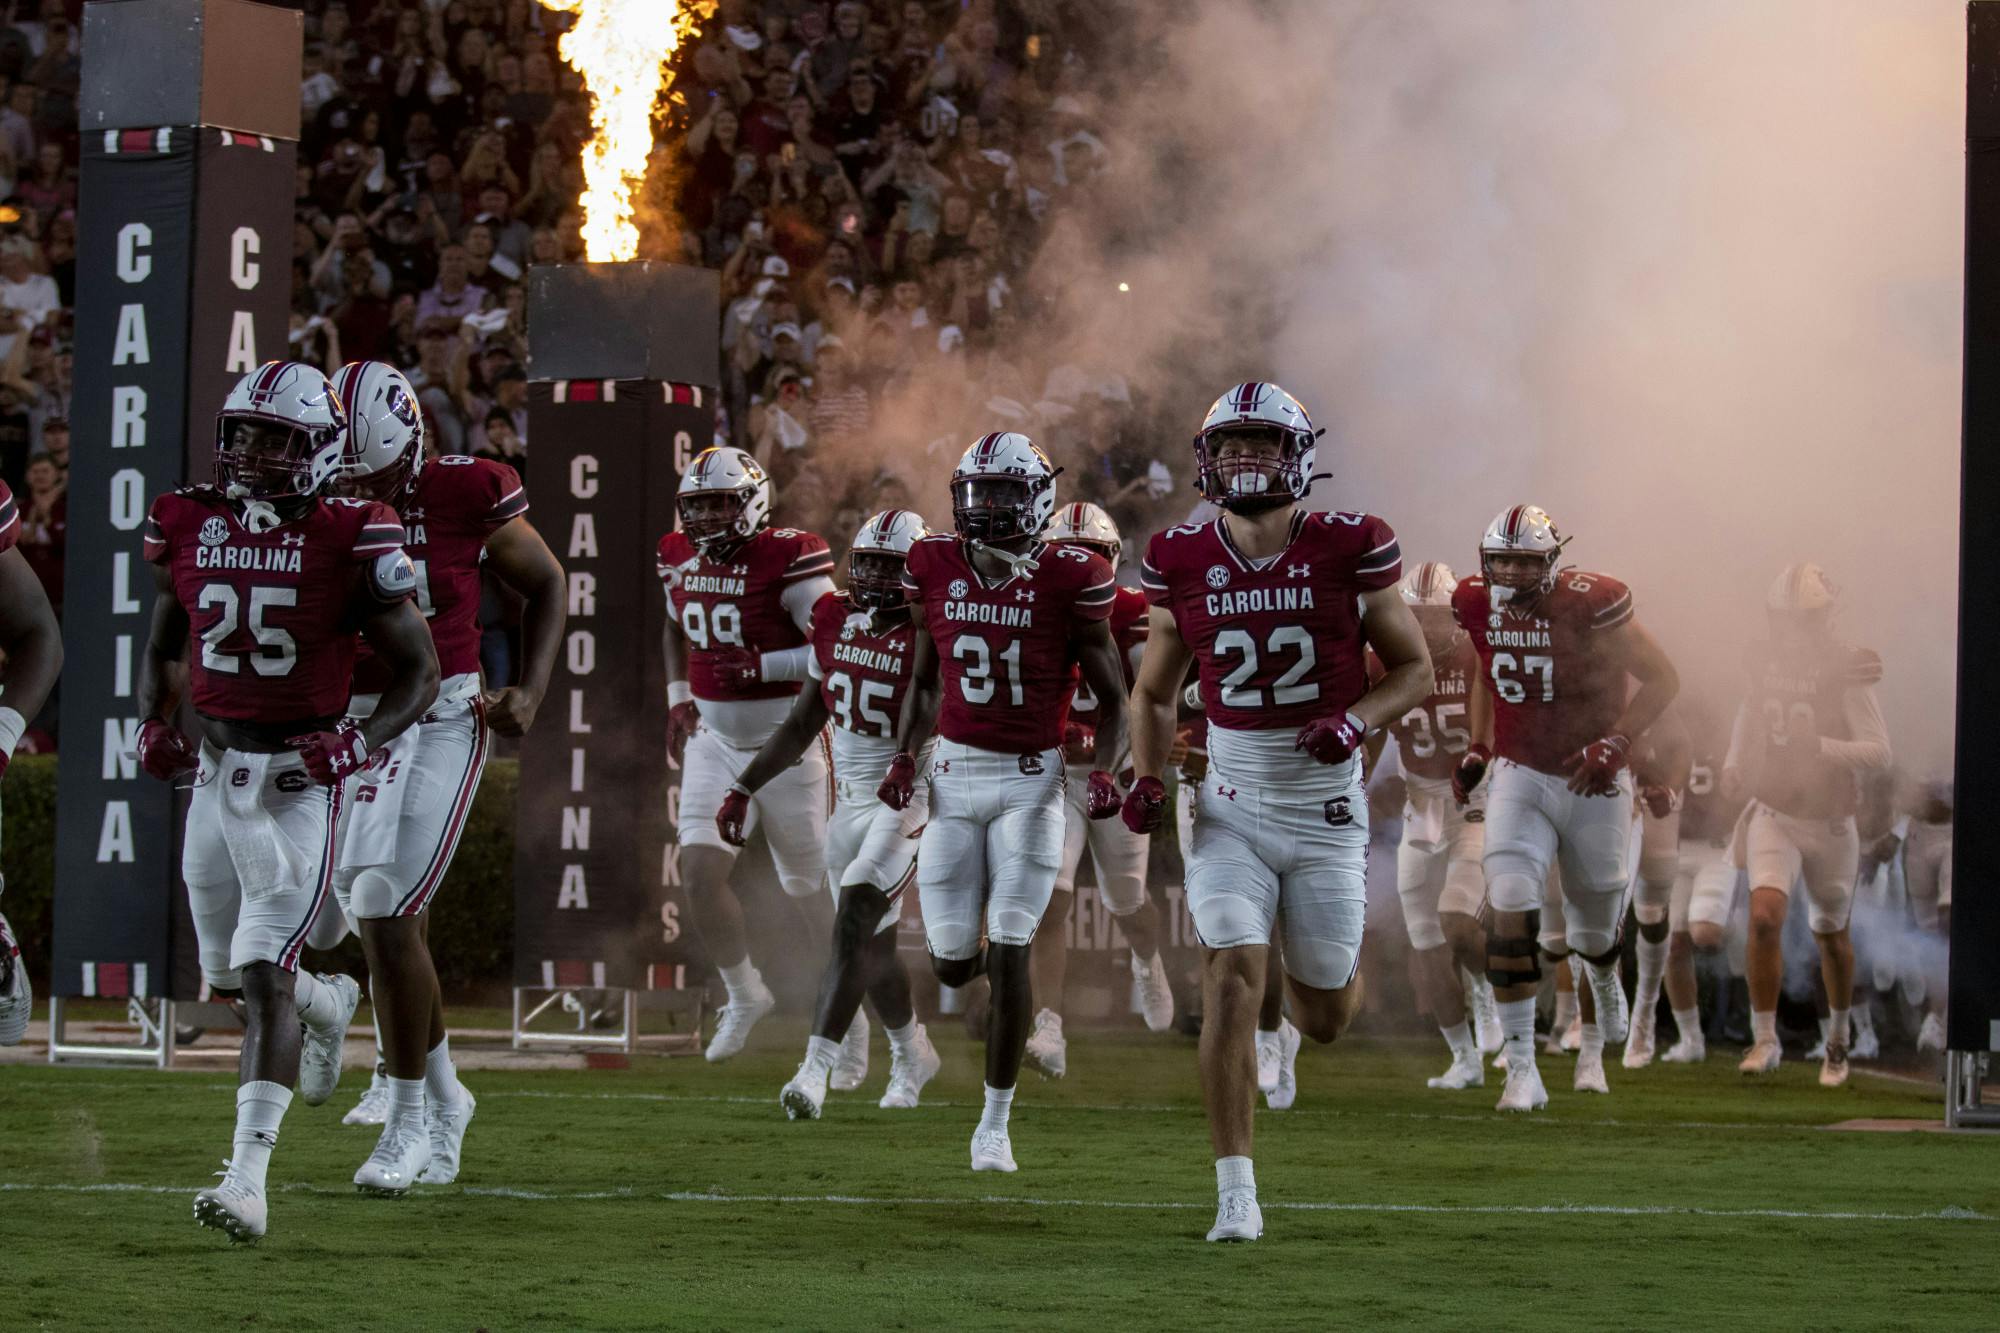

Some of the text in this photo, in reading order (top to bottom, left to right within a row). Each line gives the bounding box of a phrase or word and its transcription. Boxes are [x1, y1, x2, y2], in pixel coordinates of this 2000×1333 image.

[97, 222, 152, 862] CAROLINA
[204, 517, 226, 539] SEC
[196, 546, 301, 573] CAROLINA
[1208, 568, 1229, 587] SEC
[684, 576, 745, 596] CAROLINA
[949, 580, 968, 598] SEC
[1206, 587, 1315, 616] CAROLINA
[198, 583, 297, 676] 25
[682, 602, 745, 649] 99
[944, 601, 1032, 628] CAROLINA
[833, 643, 902, 675] CAROLINA
[1486, 631, 1551, 648] CAROLINA
[557, 455, 599, 909] CAROLINA
[953, 634, 1024, 706] 31
[1214, 625, 1320, 707] 22
[1491, 653, 1554, 703] 67
[827, 671, 895, 738] 35
[1401, 703, 1470, 758] 35
